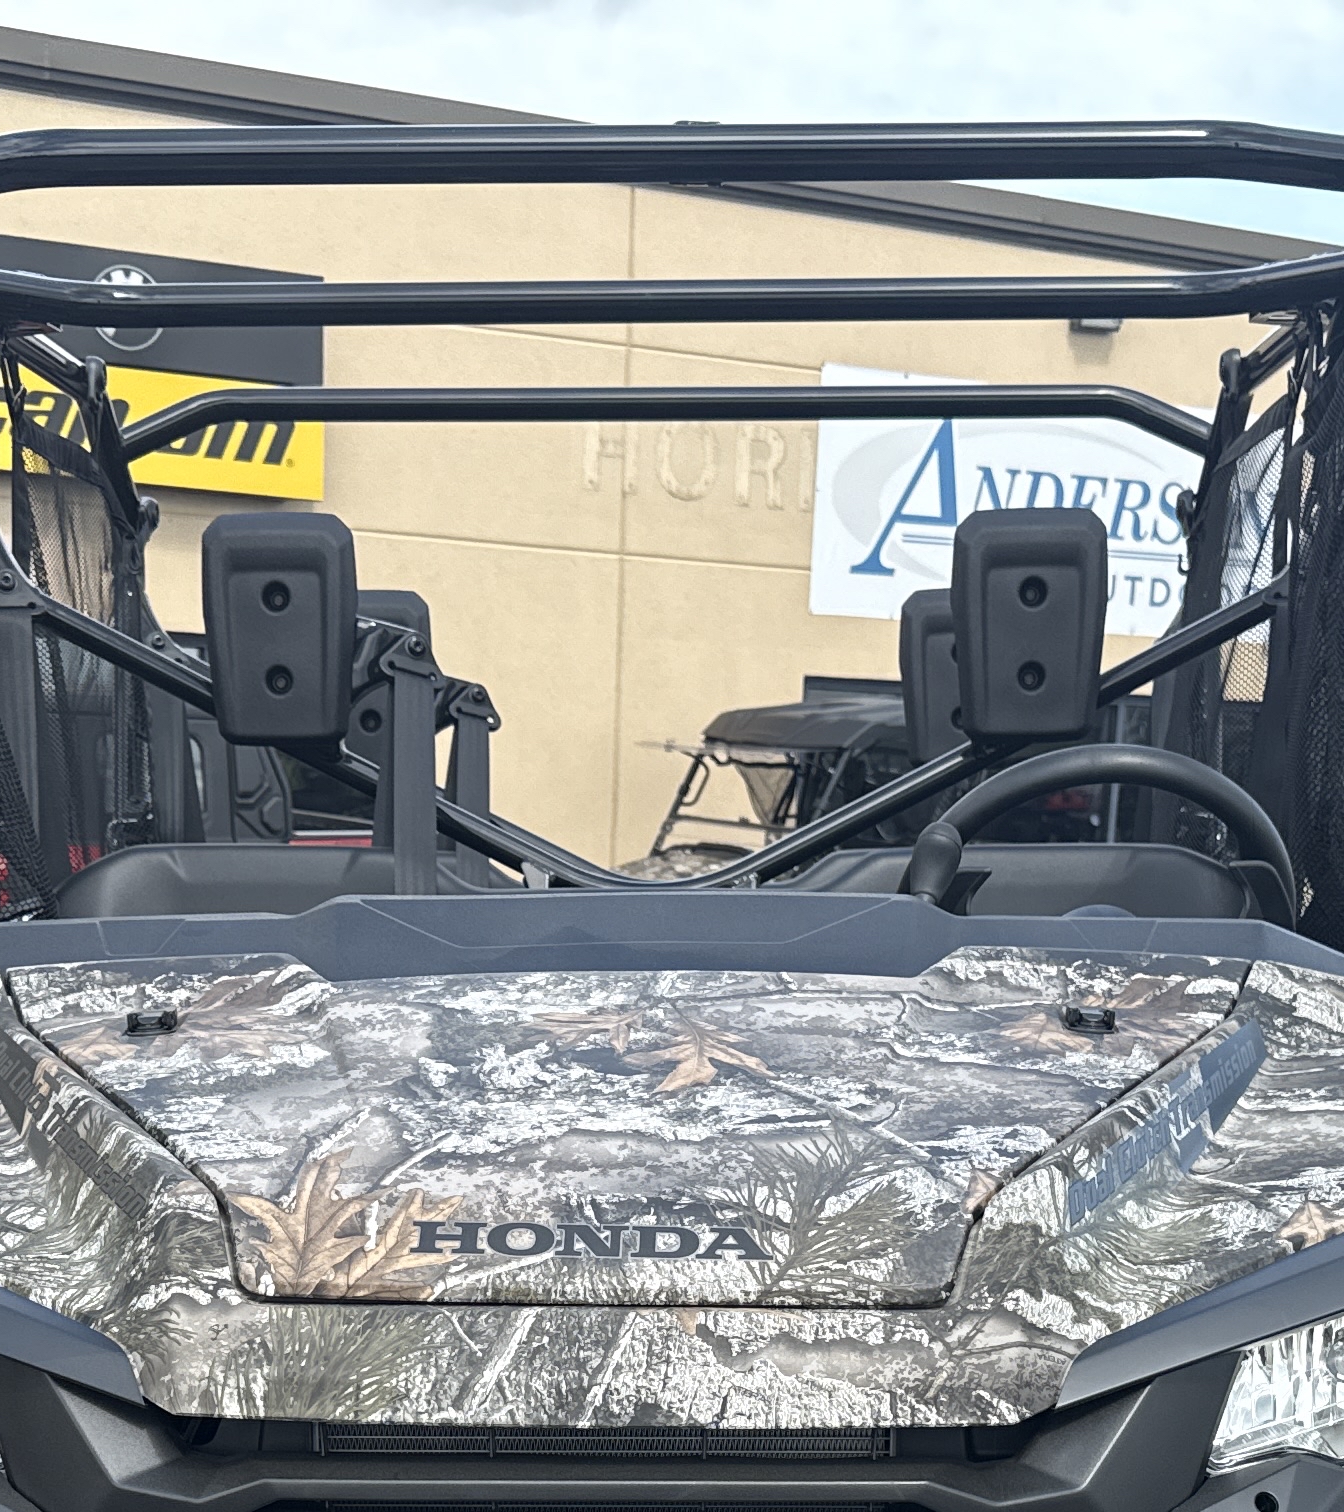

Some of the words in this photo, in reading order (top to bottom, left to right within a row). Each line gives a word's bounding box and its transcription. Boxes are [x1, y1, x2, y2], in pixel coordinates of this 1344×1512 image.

[42, 1102, 147, 1220] Transmission
[1068, 1152, 1116, 1227] Dual
[1118, 1108, 1171, 1184] Clutch
[1167, 1040, 1257, 1138] Transmission
[409, 1220, 773, 1261] HONDA
